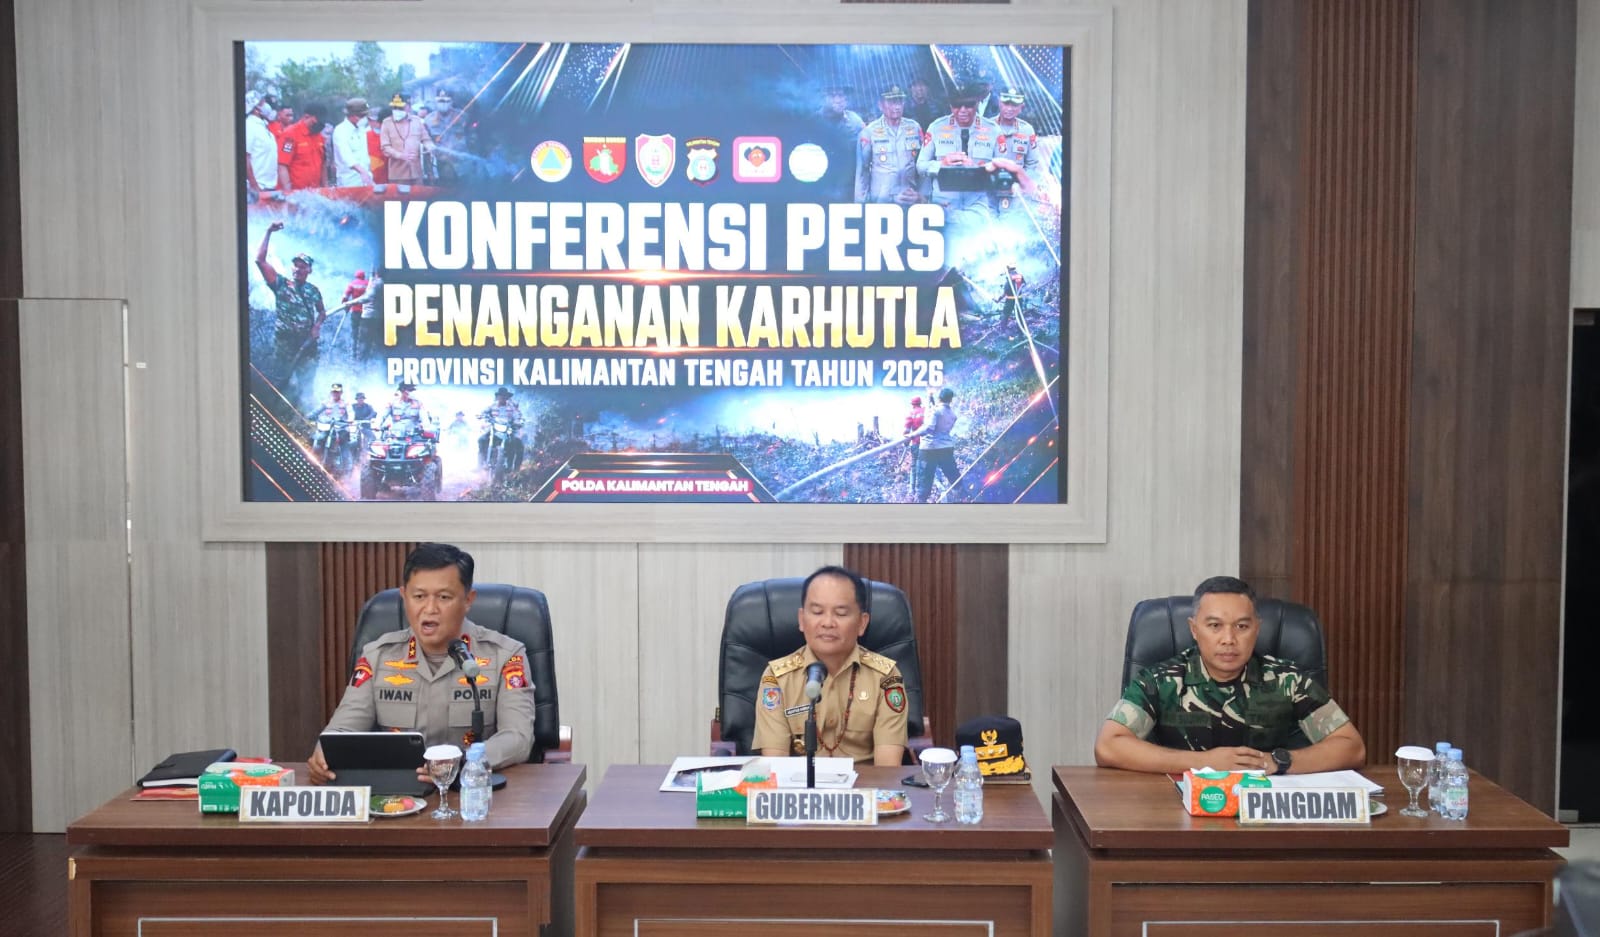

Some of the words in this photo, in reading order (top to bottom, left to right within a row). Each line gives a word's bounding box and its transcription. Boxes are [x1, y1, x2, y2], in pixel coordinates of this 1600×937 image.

[383, 200, 767, 272] KONFERENSI
[786, 202, 946, 273] PERS
[383, 283, 701, 348] PENANGANAN
[716, 284, 962, 349] KARHUTLA
[387, 358, 505, 386] PROVINSI
[514, 359, 676, 387] KALIMANTAN
[686, 359, 784, 387] TENGAH
[791, 360, 874, 387] TAHUN
[882, 360, 944, 388] 2026
[561, 479, 605, 492] POLDA
[607, 479, 694, 492] KALIMANTAN
[695, 480, 749, 493] TENGAH
[379, 689, 413, 702] IWAN
[250, 790, 356, 817] KAPOLDA
[755, 792, 864, 821] GUBERNUR
[1247, 791, 1357, 819] PANGDAM
